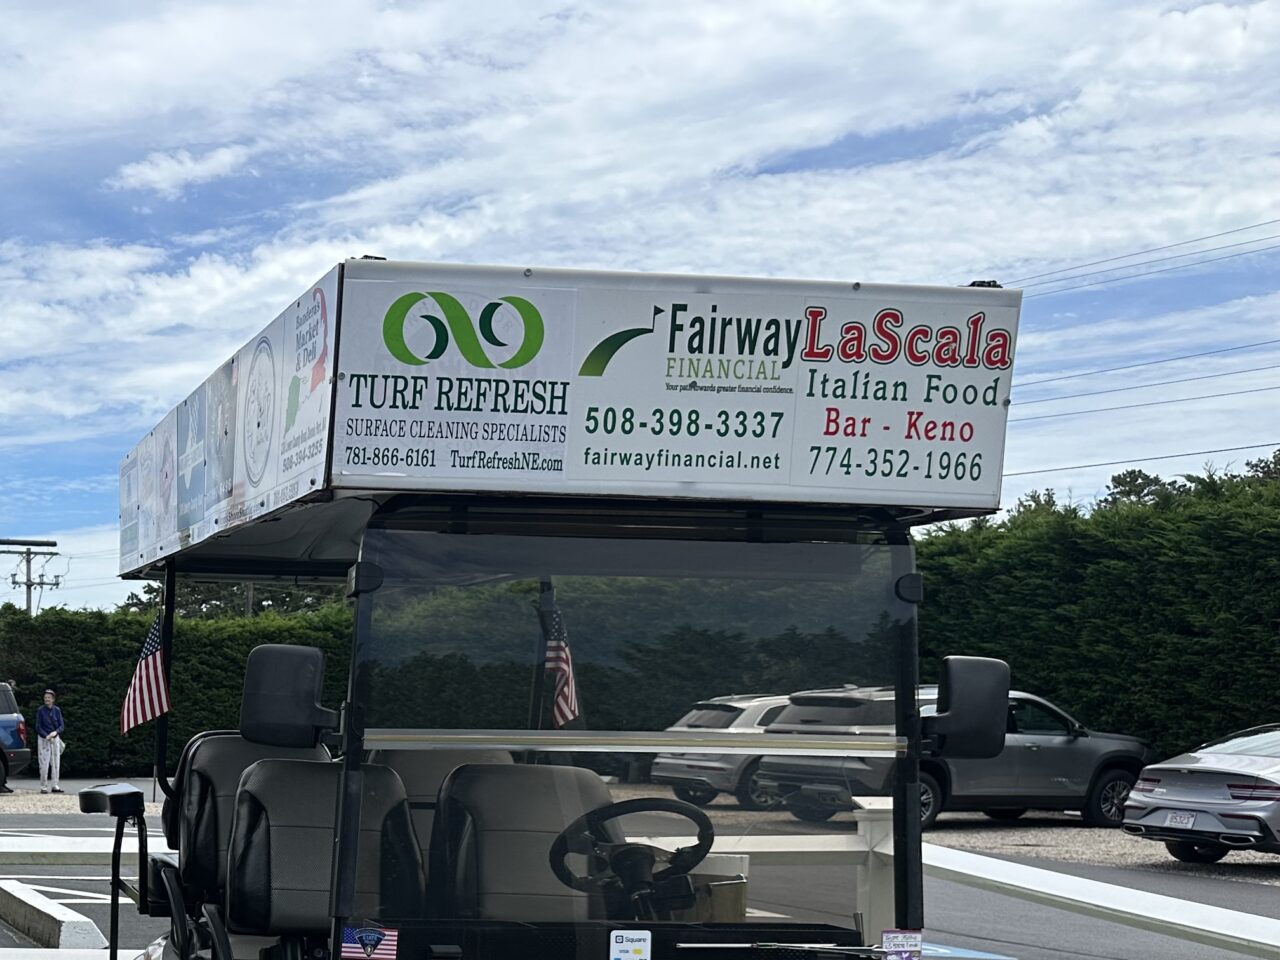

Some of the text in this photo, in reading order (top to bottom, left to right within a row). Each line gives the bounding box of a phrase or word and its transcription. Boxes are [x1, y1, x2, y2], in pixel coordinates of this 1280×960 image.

[295, 321, 320, 351] Market
[669, 303, 802, 369] Fairway
[800, 306, 1012, 370] LaScala
[295, 340, 317, 372] & Deli
[666, 357, 781, 381] FINANCIAL
[349, 374, 570, 416] TURF REFRESH
[665, 383, 678, 391] Your
[717, 385, 737, 393] greater
[738, 385, 761, 393] financial
[806, 368, 1000, 406] Italian Food
[346, 418, 406, 438] SURFACE
[409, 420, 479, 441] CLEANING
[483, 422, 567, 444] SPECIALISTS
[585, 407, 784, 440] 508-398-3337
[824, 407, 871, 437] Bar
[906, 410, 975, 442] Keno
[282, 437, 323, 473] 508-394-3255
[346, 447, 563, 472] 781-866-6161 TurfRefreshNE.com
[583, 448, 780, 472] fairwayfinancial.net
[809, 445, 983, 482] 774-352-1966
